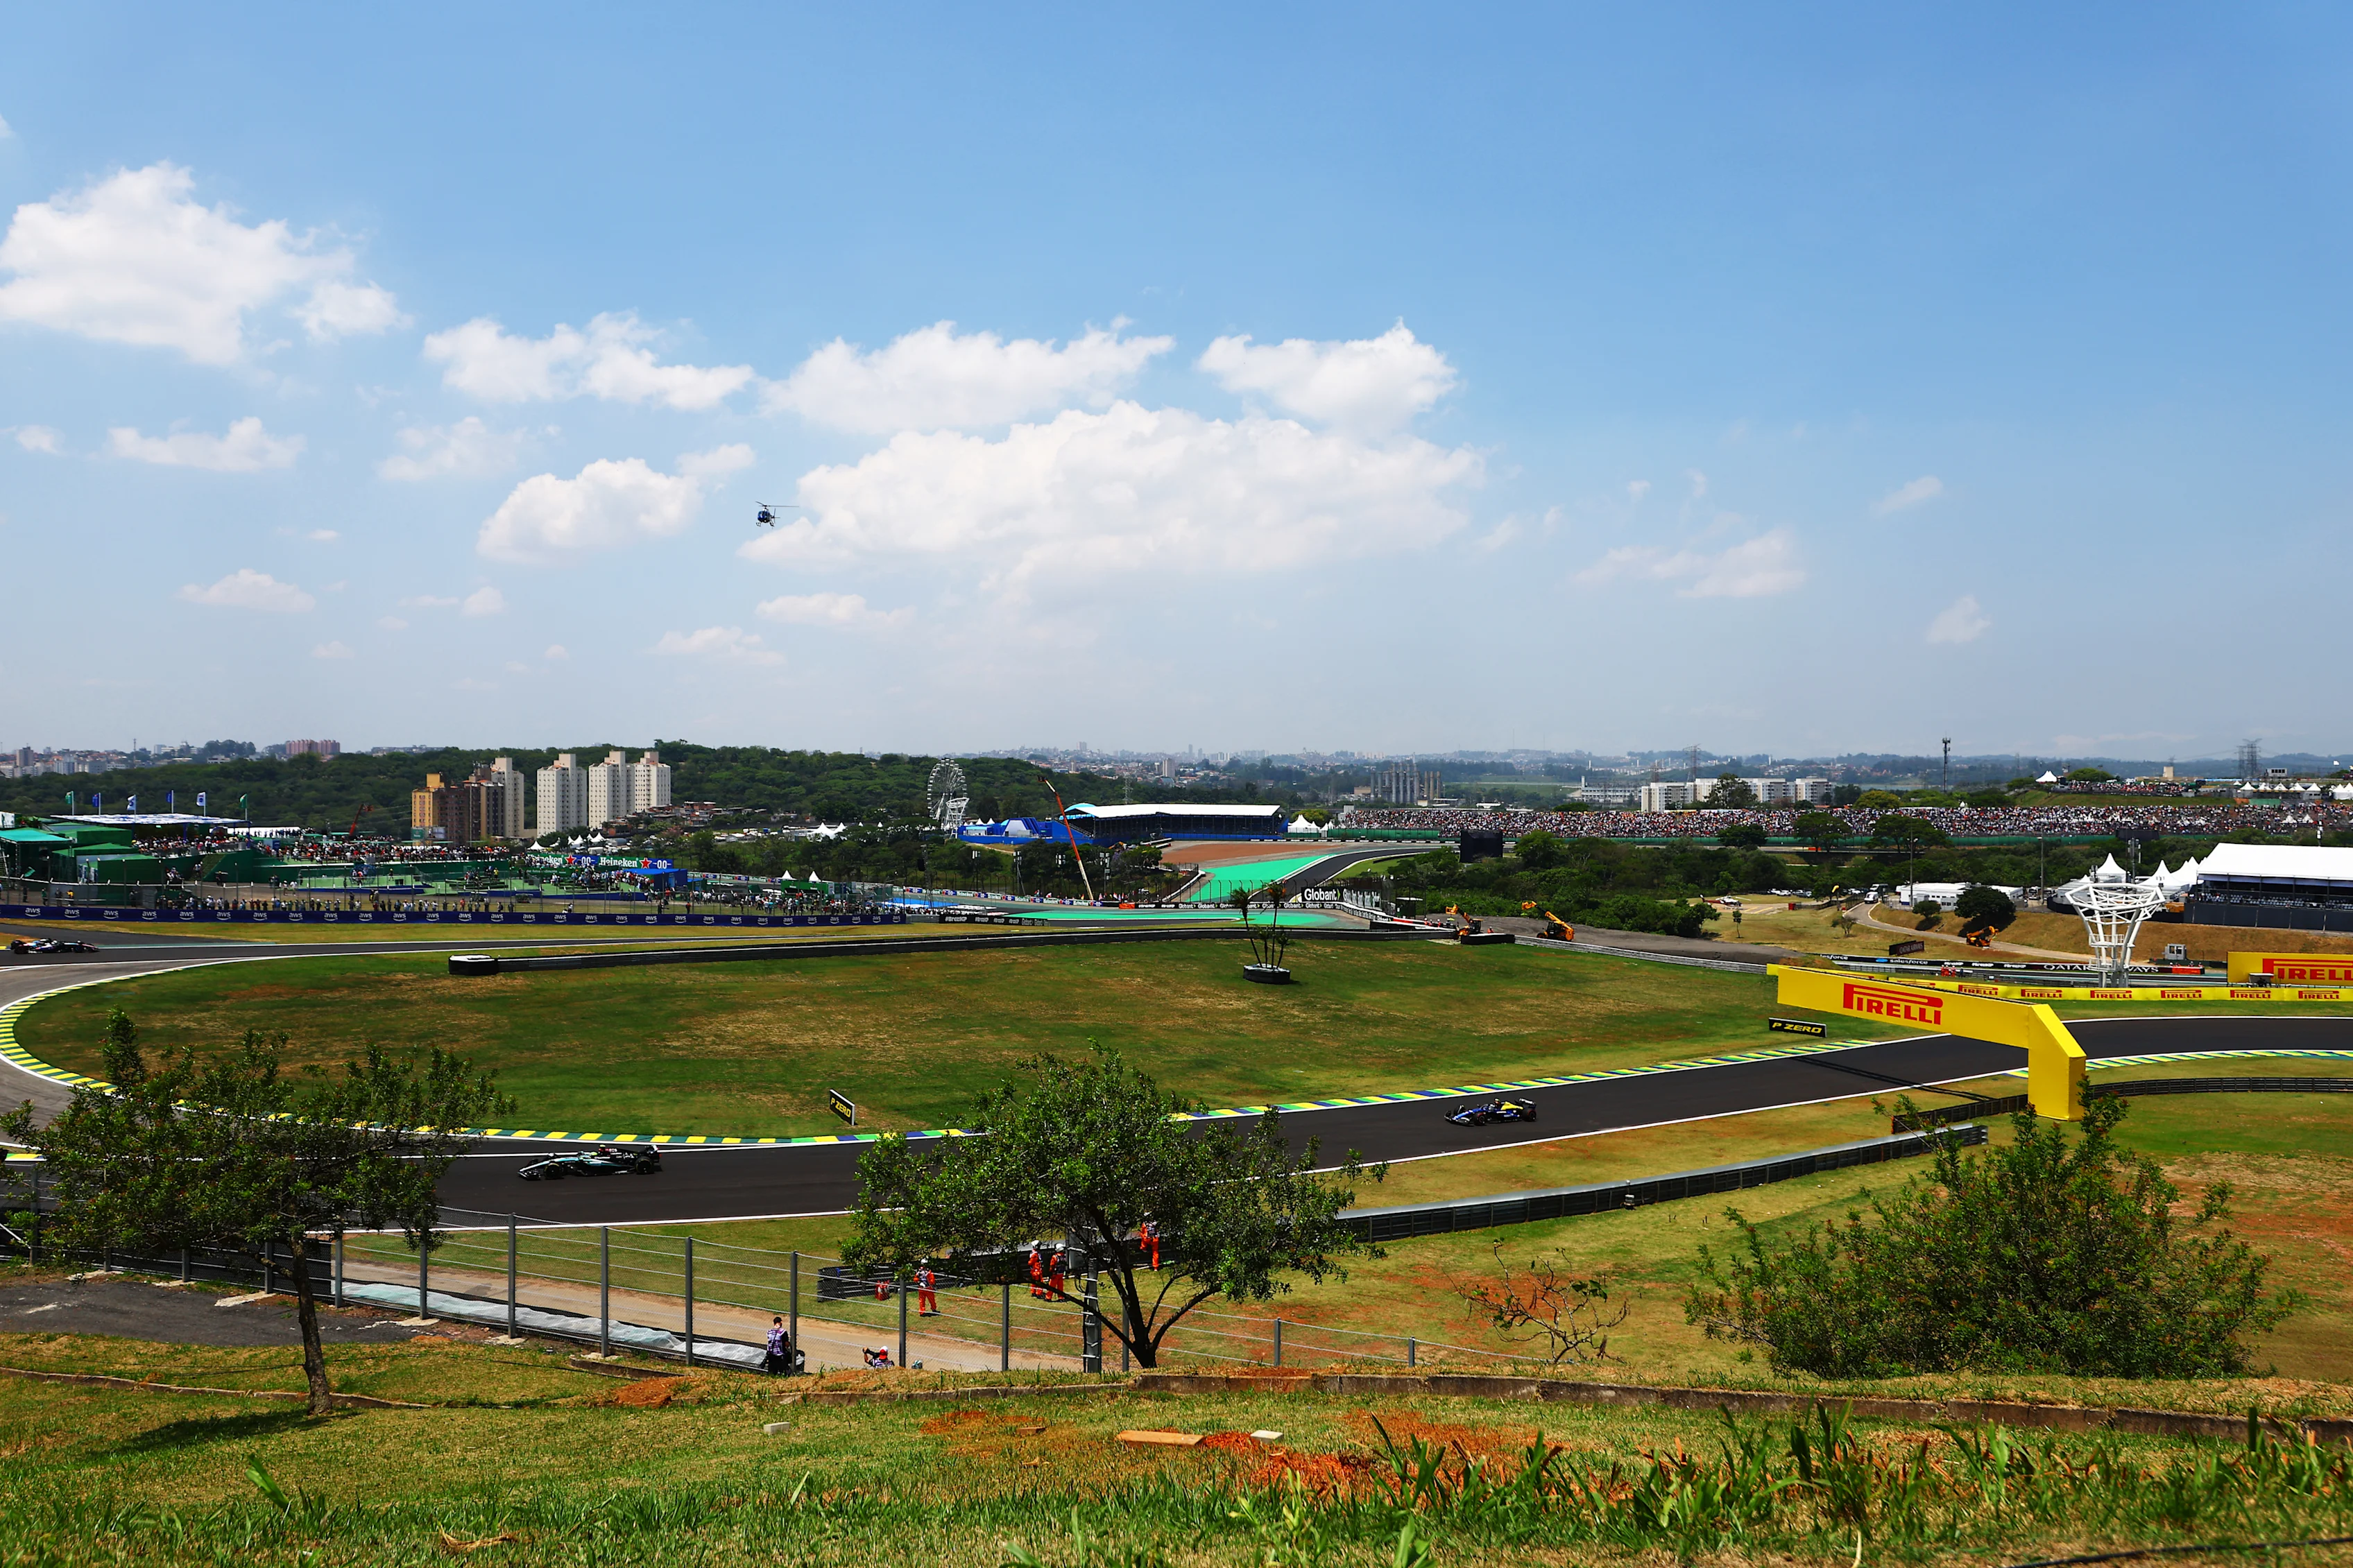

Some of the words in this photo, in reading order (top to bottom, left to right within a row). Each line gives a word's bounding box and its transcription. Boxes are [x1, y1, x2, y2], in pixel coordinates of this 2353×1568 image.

[599, 856, 638, 868] Heineken
[1304, 888, 1337, 901] Globant
[1958, 984, 1999, 995] PIRELLI
[2021, 989, 2062, 998] PIRELLI
[2090, 990, 2132, 999] PIRELLI
[2160, 990, 2202, 999] PIRELLI
[2230, 990, 2271, 999] PIRELLI
[2298, 990, 2340, 999] PIRELLI
[1843, 983, 1944, 1025] PIRELLI
[1783, 1024, 1822, 1034] ZERO
[835, 1101, 851, 1117] ZERO
